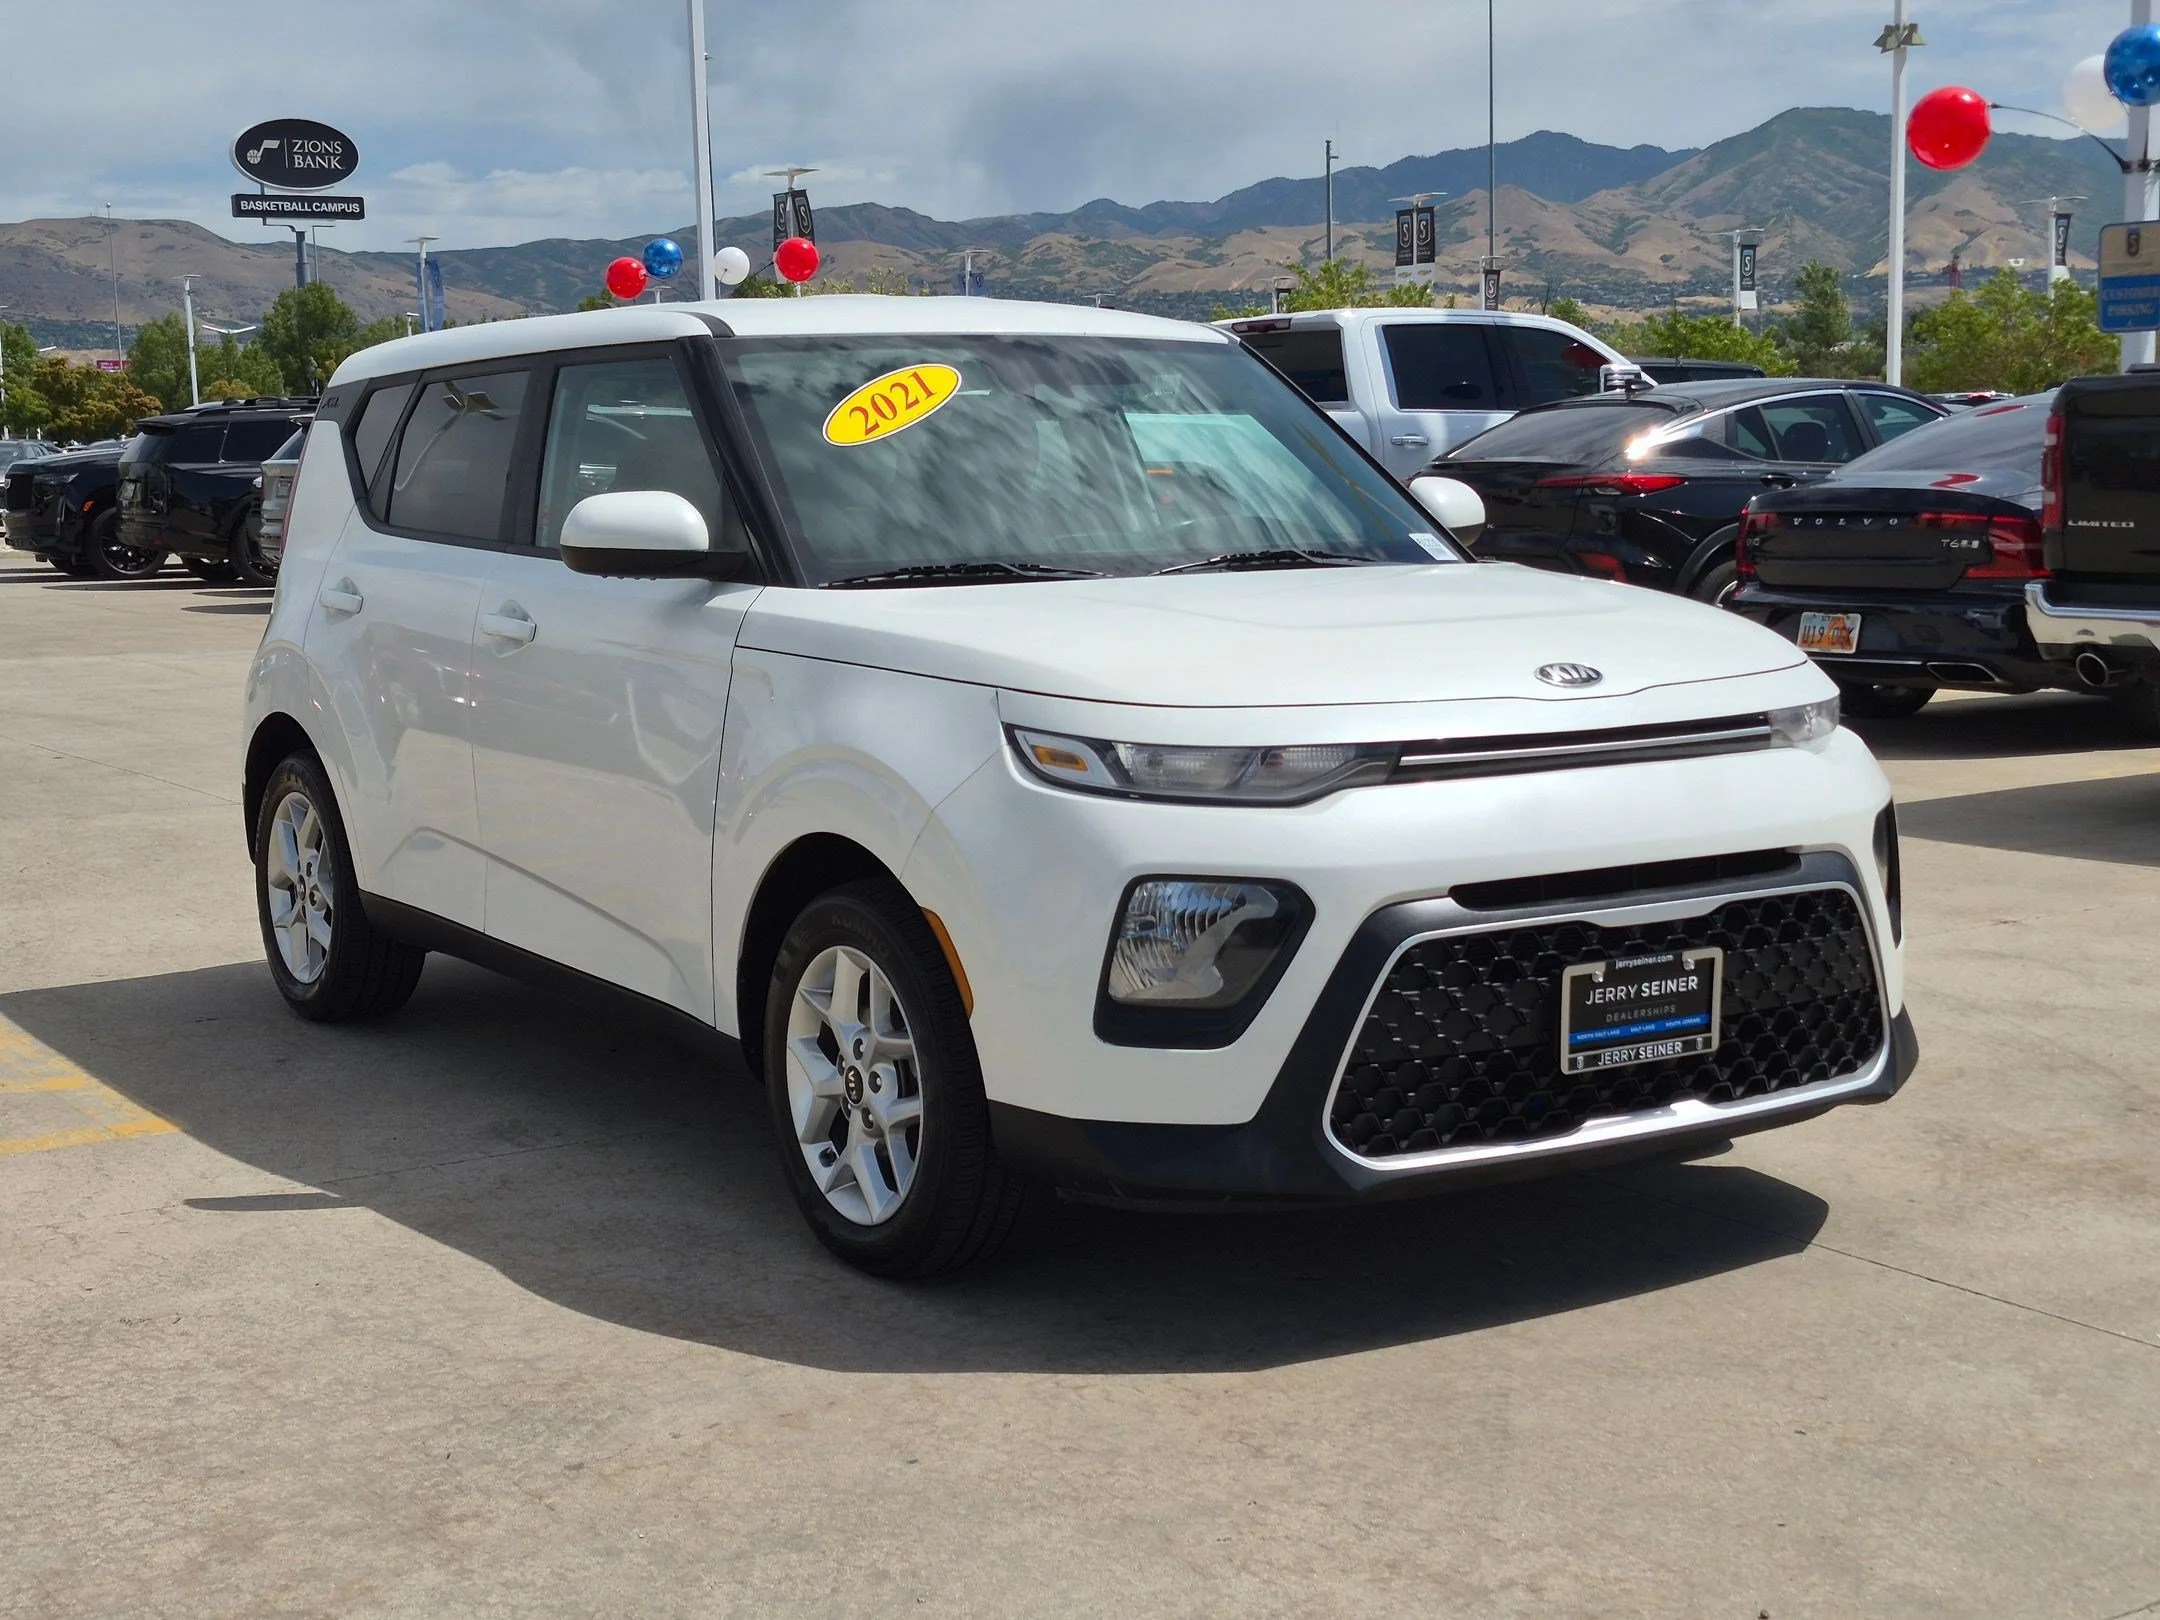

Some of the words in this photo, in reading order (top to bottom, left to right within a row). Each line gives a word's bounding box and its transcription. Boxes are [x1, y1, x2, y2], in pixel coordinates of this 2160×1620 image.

[292, 139, 342, 153] ZIONS
[293, 154, 342, 169] BANK
[240, 200, 312, 212] BASKETBALL
[313, 202, 360, 213] CAMPUS
[849, 371, 937, 436] 2021
[1793, 517, 1899, 526] VOLVO
[2068, 520, 2135, 528] LIMITED
[1545, 664, 1599, 681] KIA
[1615, 954, 1674, 970] jerryseiner.com
[1585, 984, 1638, 1005] JERRY
[1640, 976, 1699, 997] SEINER
[1606, 1004, 1676, 1023] DEALERSHIPS
[1598, 1049, 1636, 1066] JERRY
[1639, 1041, 1683, 1059] SEINER
